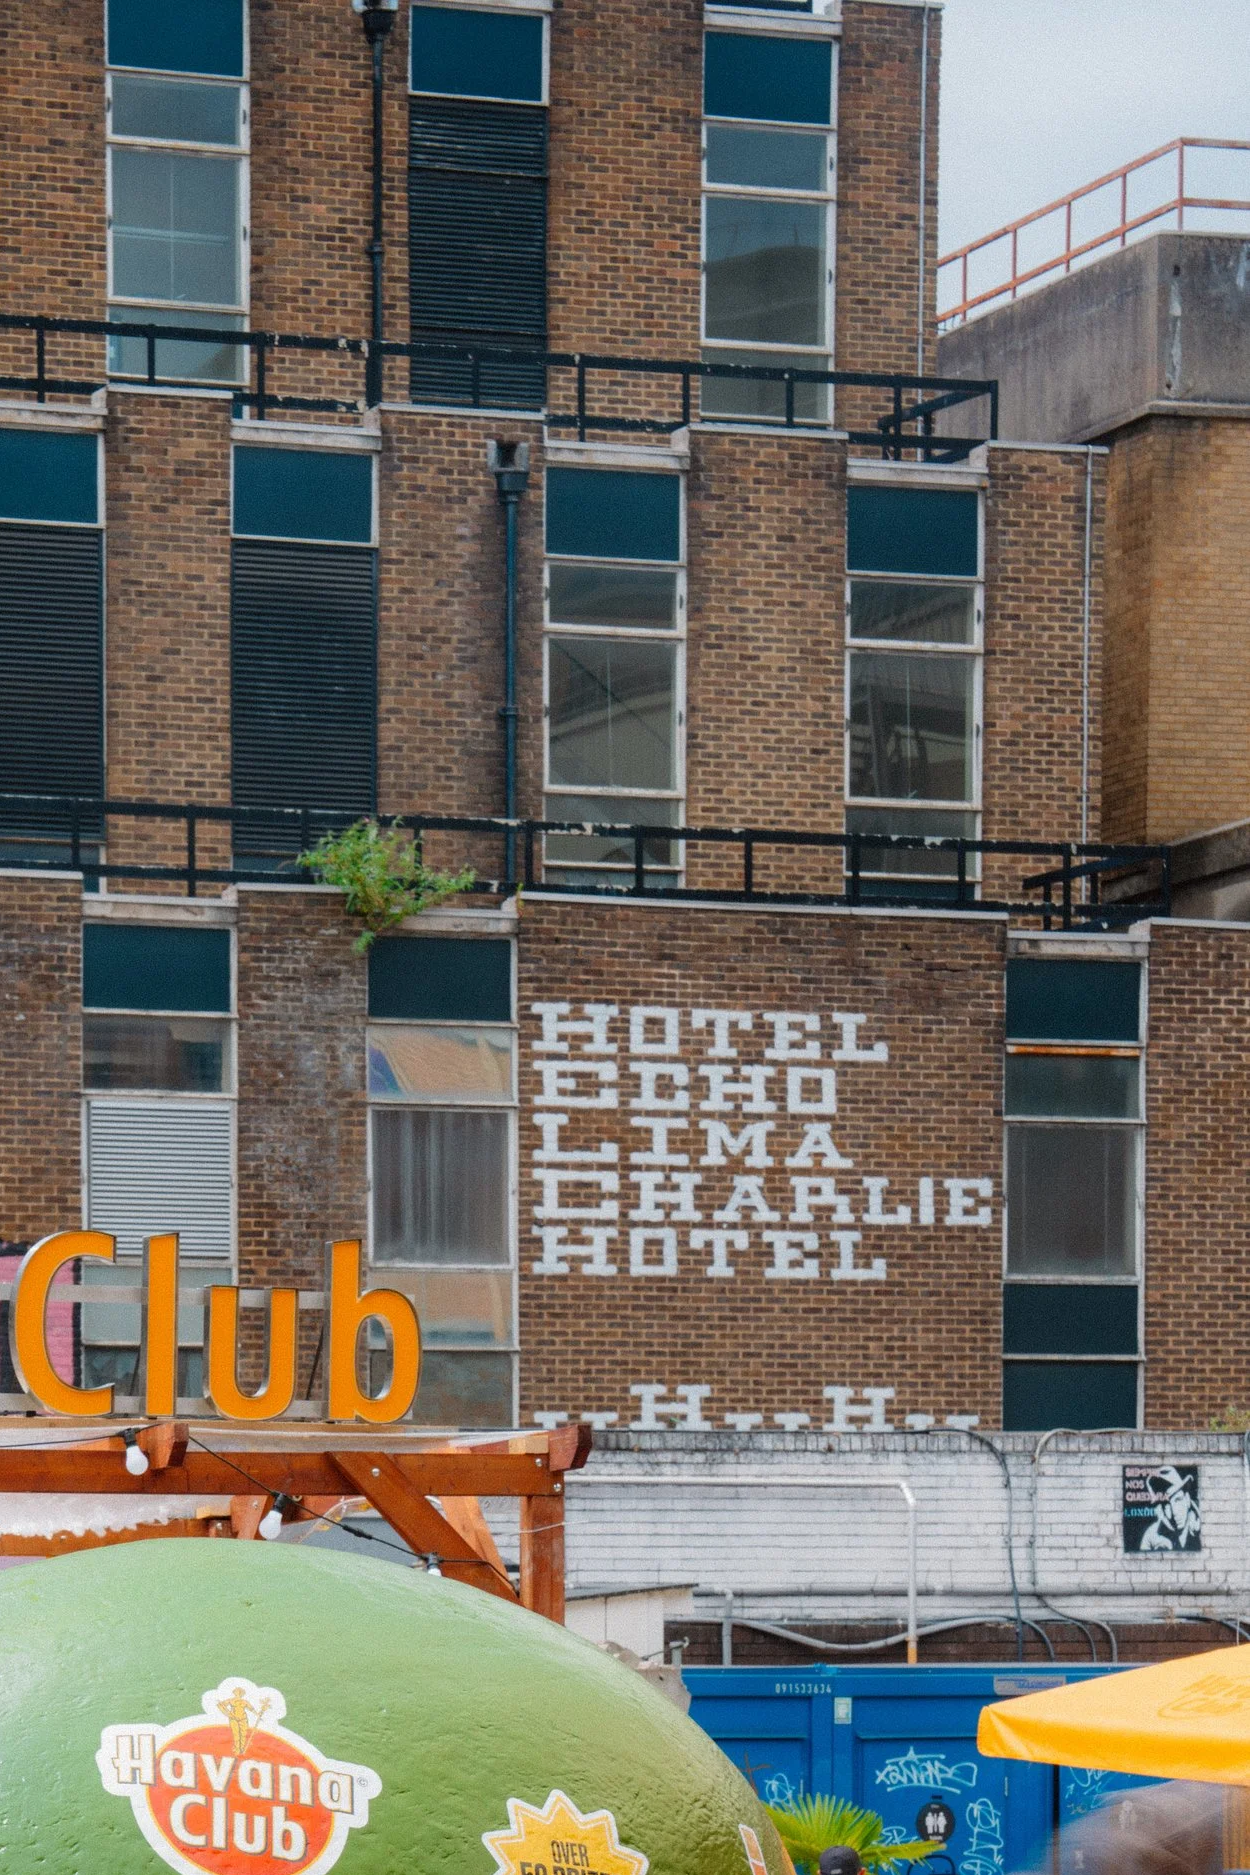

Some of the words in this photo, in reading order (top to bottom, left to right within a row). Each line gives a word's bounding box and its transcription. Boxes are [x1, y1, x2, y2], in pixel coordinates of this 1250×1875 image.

[531, 1002, 889, 1062] HOTEL
[532, 1061, 838, 1114] ECHO
[532, 1113, 854, 1168] LIMA
[532, 1168, 993, 1226] CHARLIE
[532, 1226, 887, 1280] HOTEL
[10, 1229, 422, 1424] Club
[112, 1734, 355, 1815] Havana
[169, 1793, 307, 1862] Club
[551, 1840, 590, 1867] OVER
